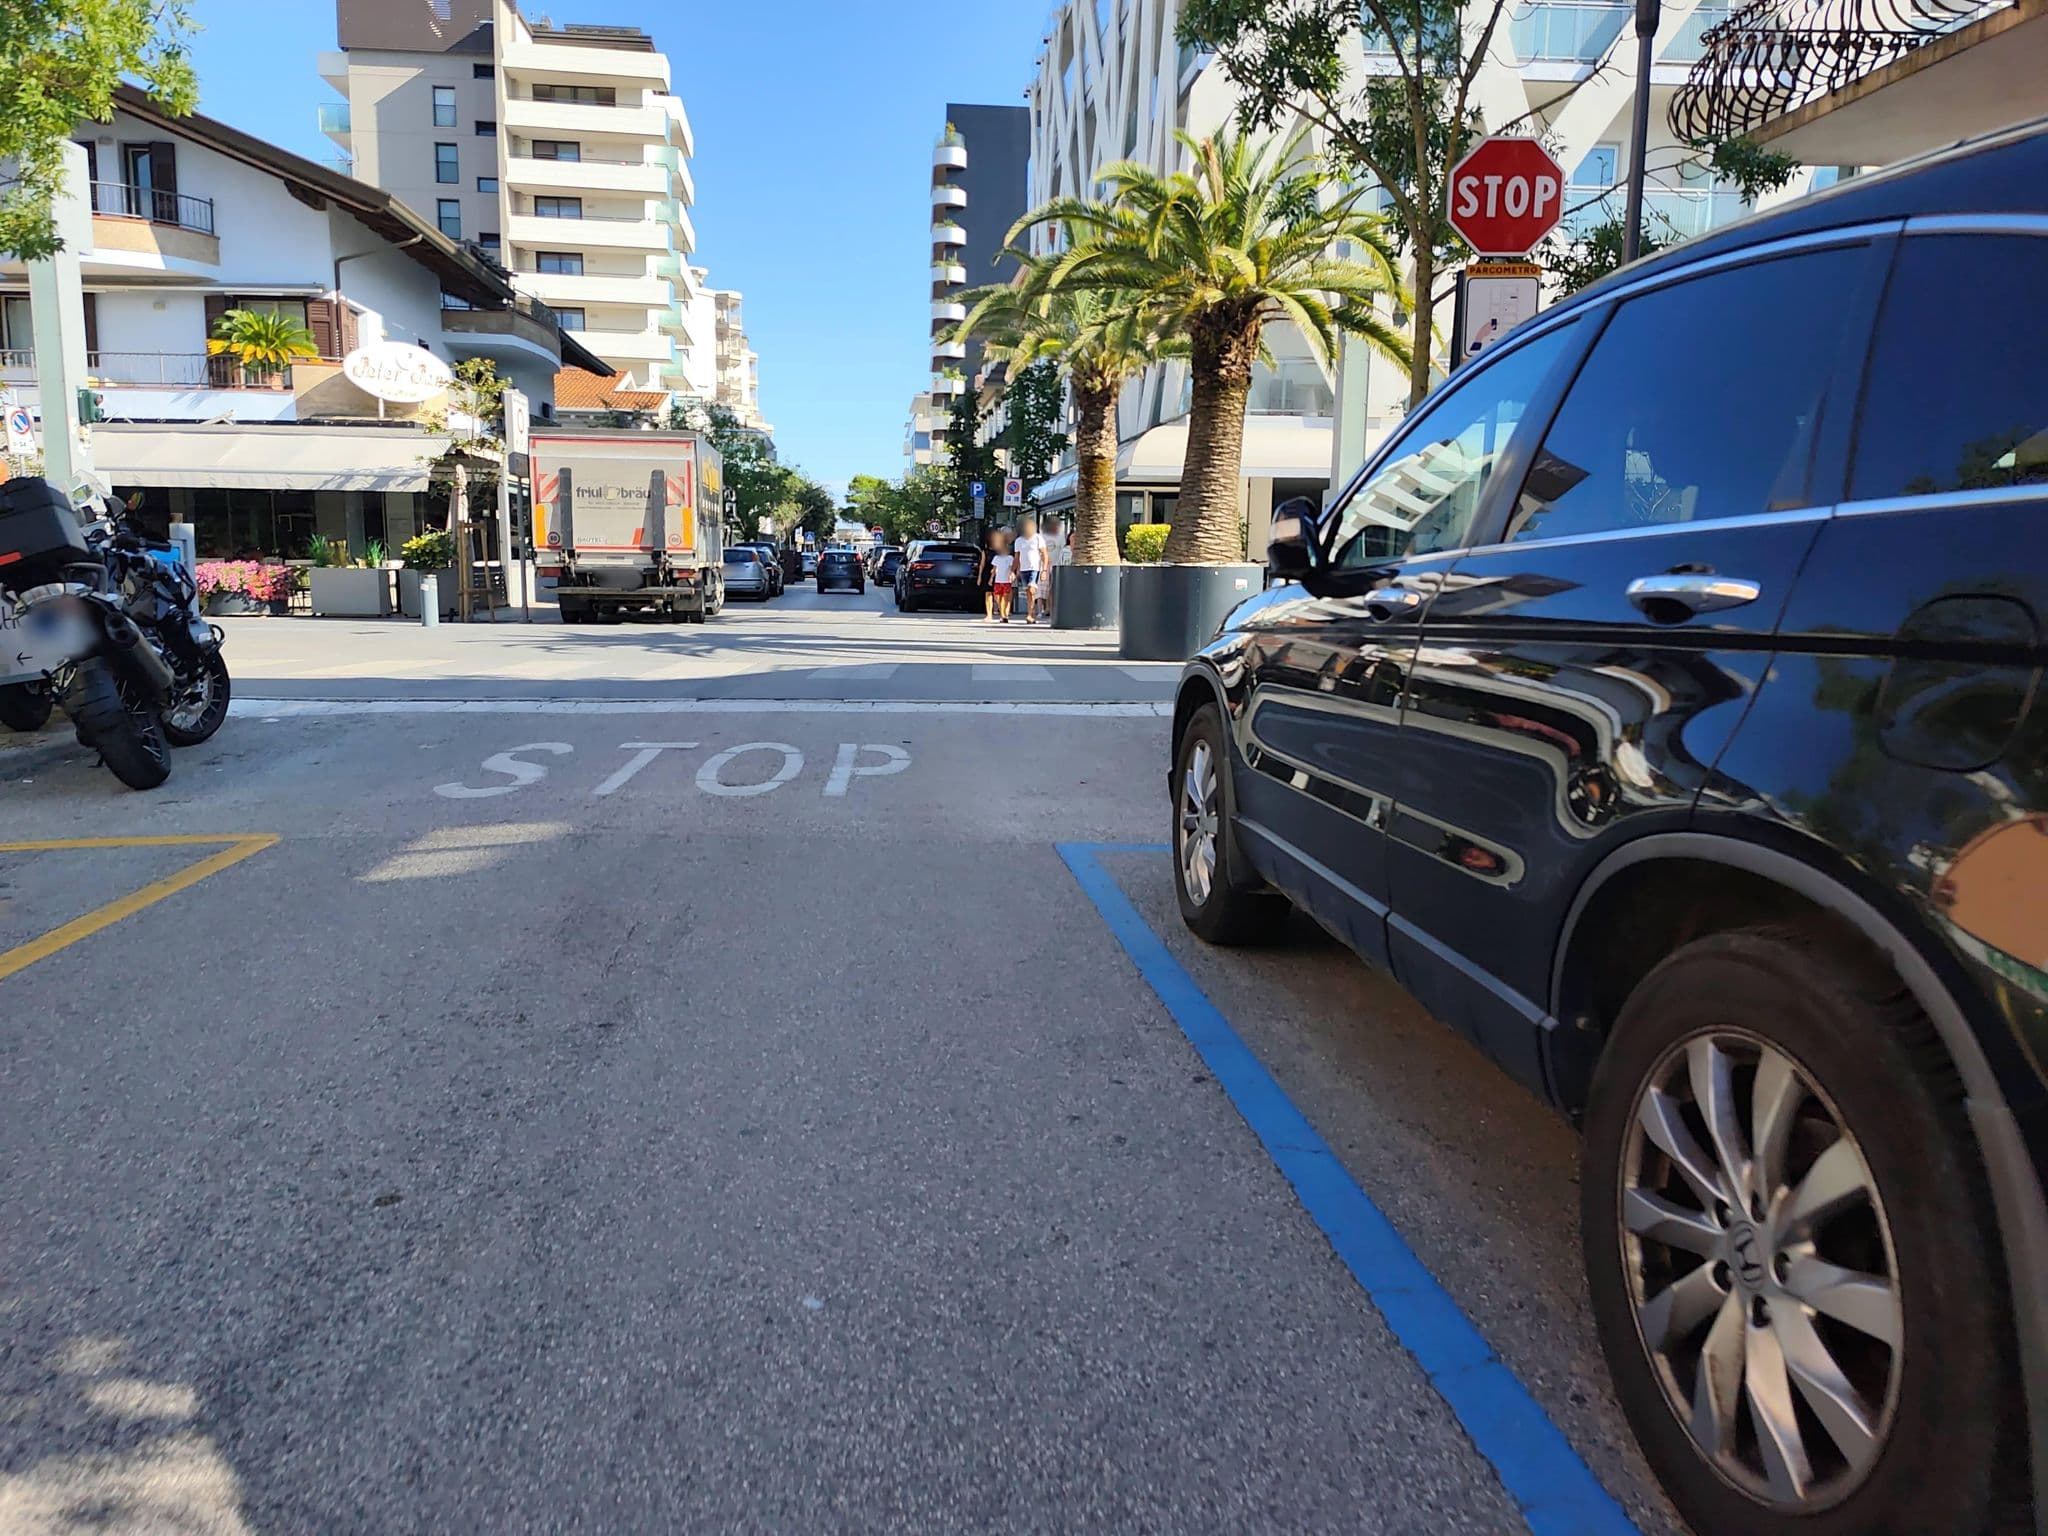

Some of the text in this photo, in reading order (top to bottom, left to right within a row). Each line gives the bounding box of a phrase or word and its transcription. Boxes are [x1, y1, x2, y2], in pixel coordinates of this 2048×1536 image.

[1457, 175, 1557, 218] STOP
[1469, 265, 1539, 275] PARCOMETRO
[576, 486, 602, 498] friul
[973, 483, 983, 495] P
[433, 741, 912, 798] STOP
